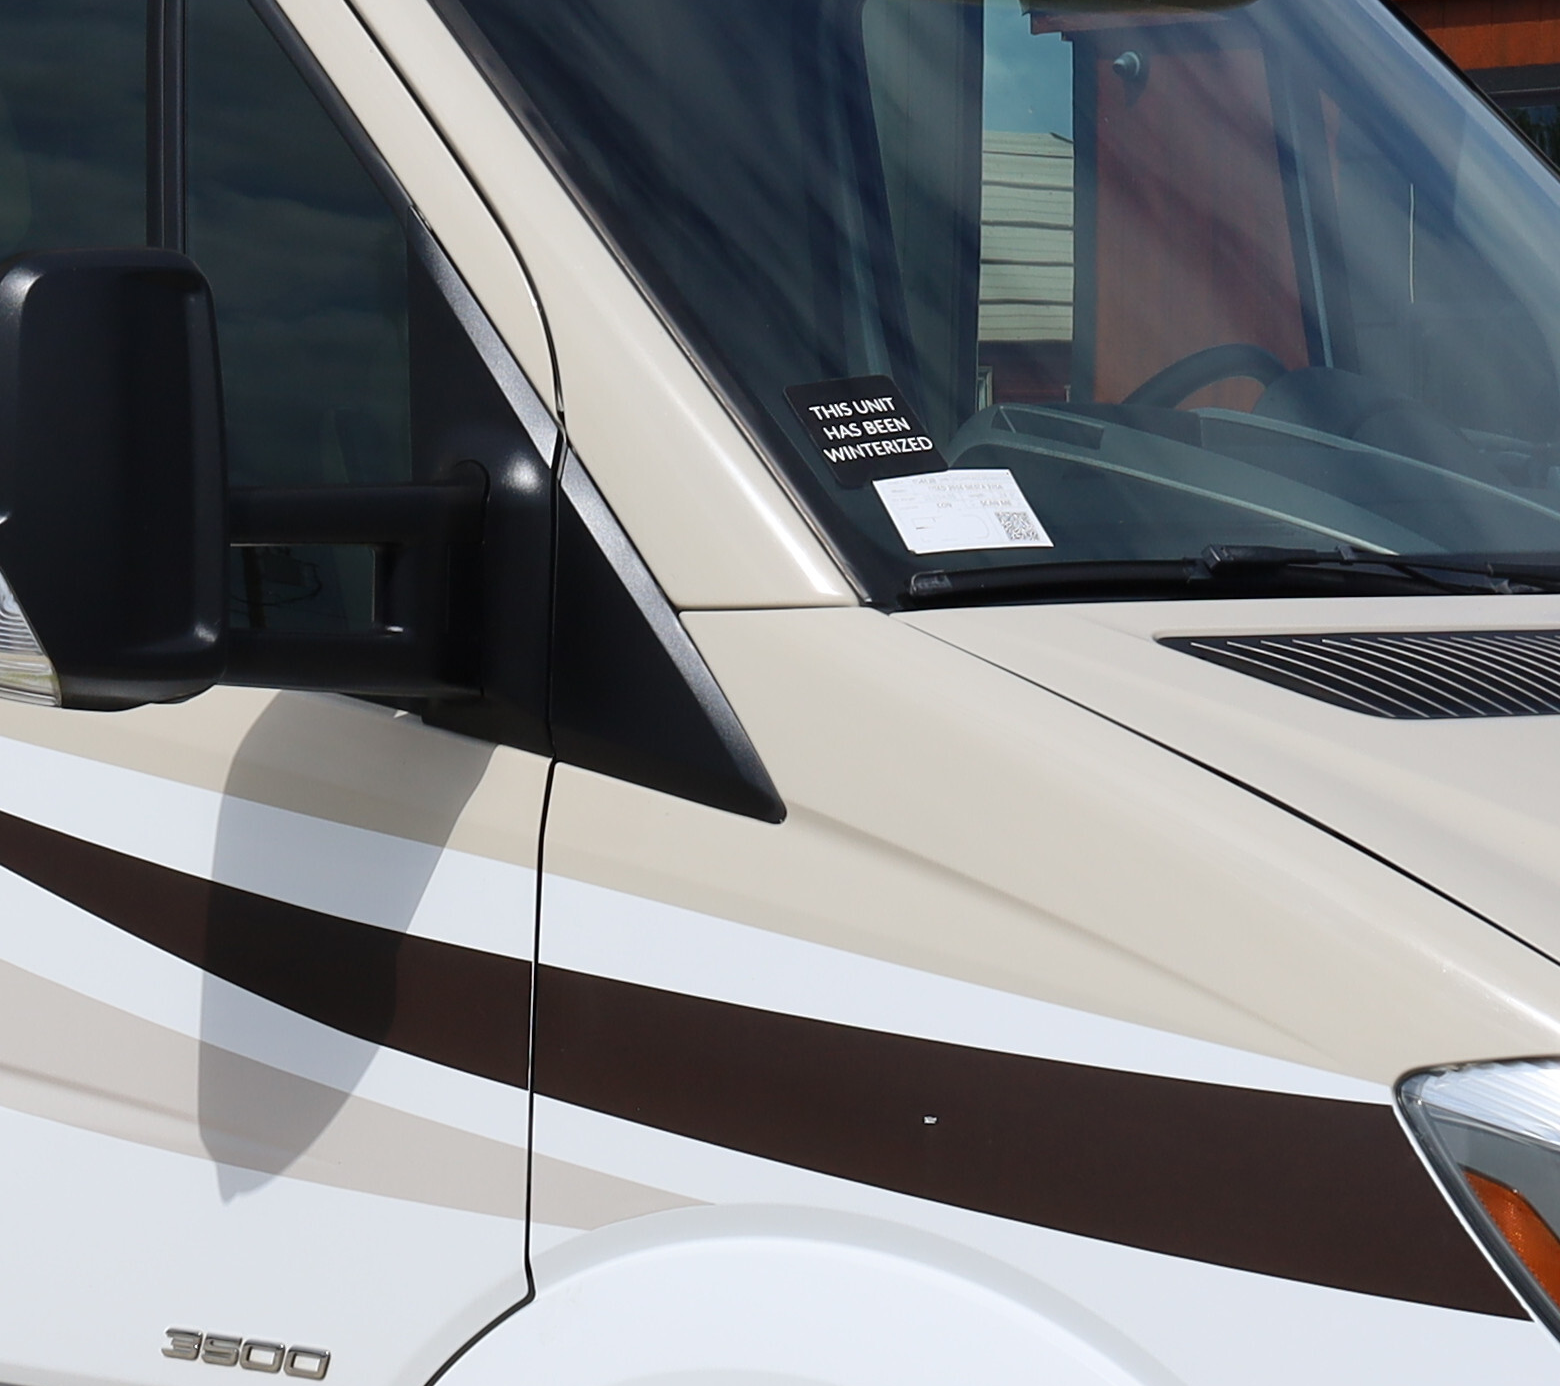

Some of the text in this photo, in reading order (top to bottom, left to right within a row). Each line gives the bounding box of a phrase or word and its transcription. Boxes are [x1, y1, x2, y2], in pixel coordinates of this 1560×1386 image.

[809, 397, 896, 421] THIS UNIT
[823, 417, 911, 441] HAS BEEN
[823, 436, 933, 463] WINTERIZED
[161, 1326, 331, 1381] 3500
